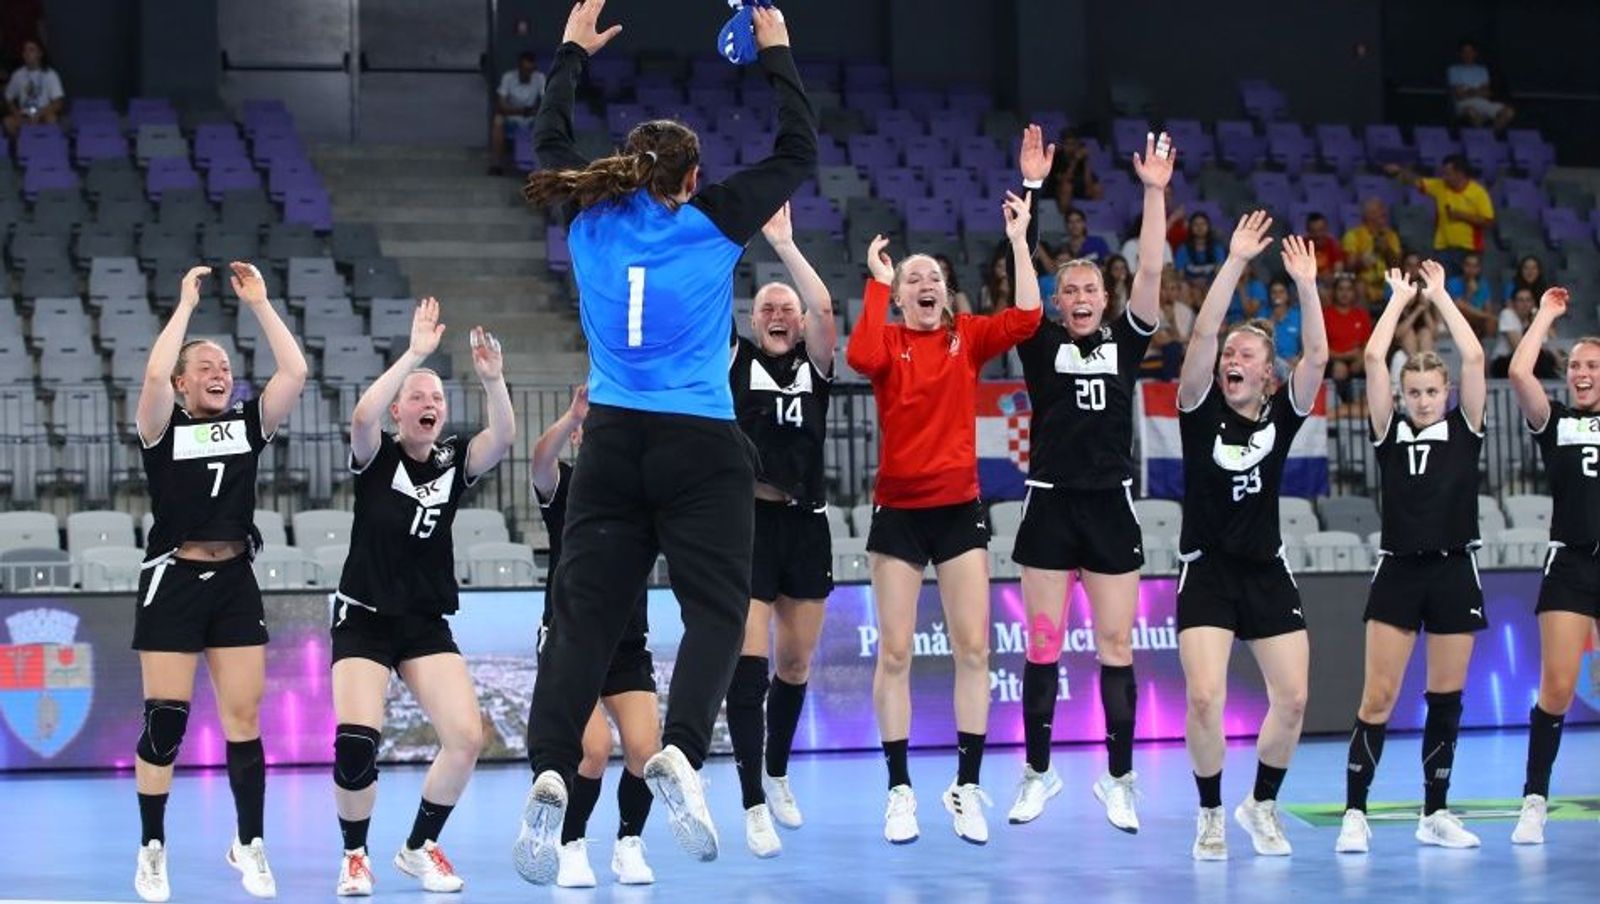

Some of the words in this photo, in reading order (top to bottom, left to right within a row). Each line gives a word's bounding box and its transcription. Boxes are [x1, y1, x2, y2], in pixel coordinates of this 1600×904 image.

[628, 266, 645, 347] 1
[1075, 379, 1106, 411] 20
[776, 397, 803, 428] 14
[1408, 445, 1432, 475] 17
[207, 462, 226, 497] 7
[1232, 466, 1262, 501] 23
[409, 505, 441, 539] 15
